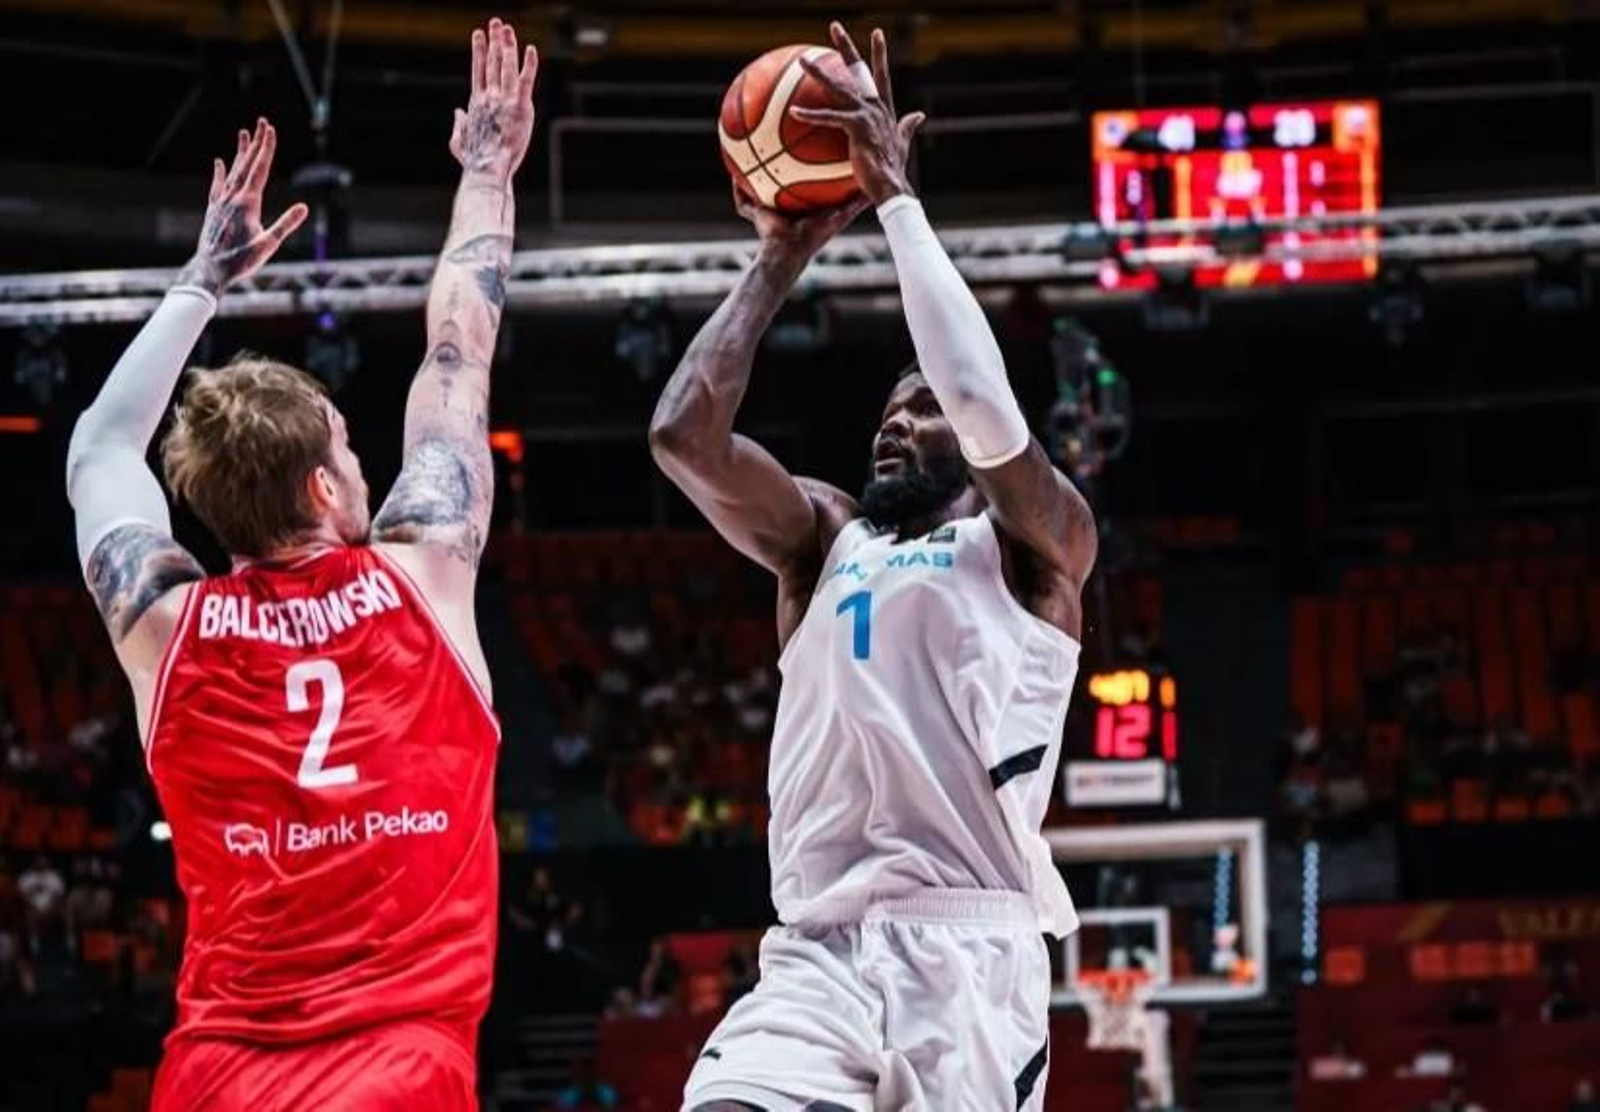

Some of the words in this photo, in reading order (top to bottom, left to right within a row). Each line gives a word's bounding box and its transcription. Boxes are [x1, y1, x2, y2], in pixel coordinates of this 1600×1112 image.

[198, 569, 402, 647] BALCEROWSKI
[836, 589, 872, 661] 1
[285, 657, 360, 790] 2
[1097, 705, 1151, 758] 12
[286, 815, 357, 853] Bank
[364, 807, 449, 840] Pekao
